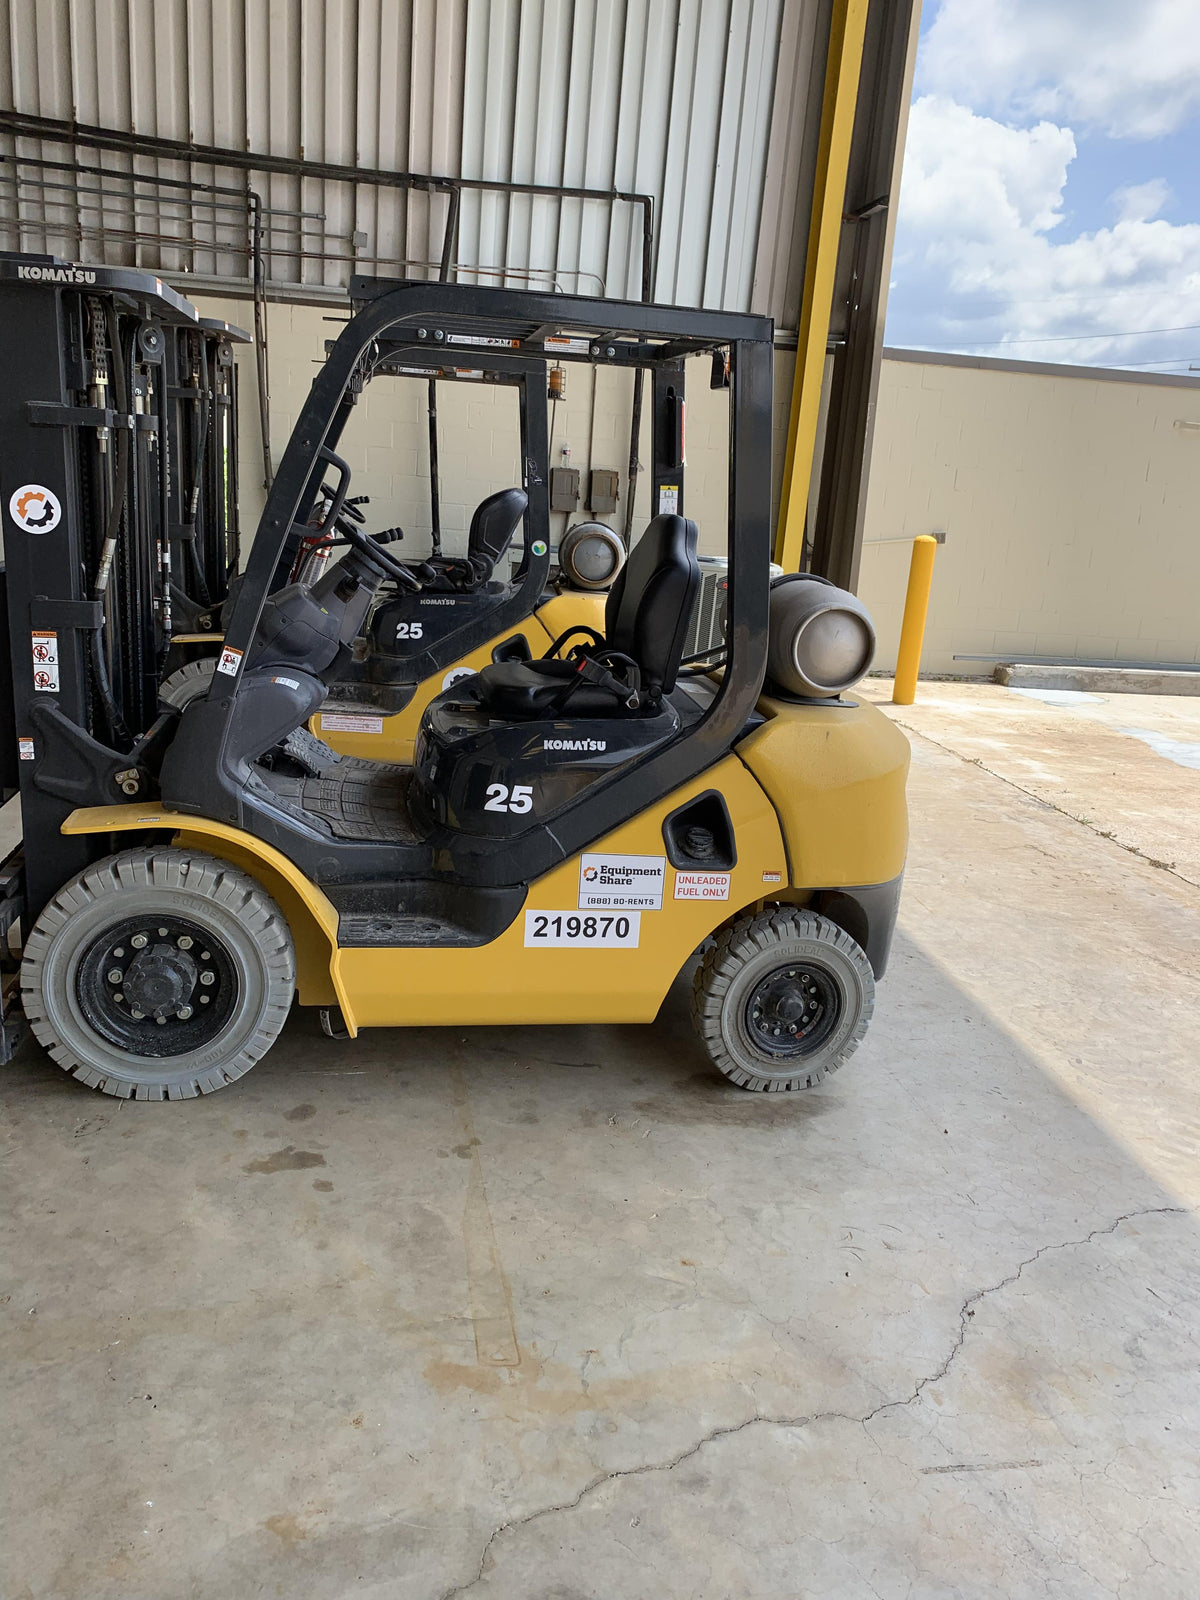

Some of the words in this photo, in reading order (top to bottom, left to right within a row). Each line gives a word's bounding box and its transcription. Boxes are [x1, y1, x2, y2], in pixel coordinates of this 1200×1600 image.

[18, 266, 96, 283] KOMATSU
[396, 622, 423, 639] 25
[543, 738, 606, 751] KOMATSU
[484, 783, 533, 814] 25
[600, 865, 662, 877] Equipment
[600, 876, 633, 885] Share
[678, 876, 727, 885] UNLEADED
[677, 888, 700, 896] FUEL
[702, 888, 726, 897] ONLY
[587, 897, 611, 905] (888)
[533, 916, 630, 938] 219870
